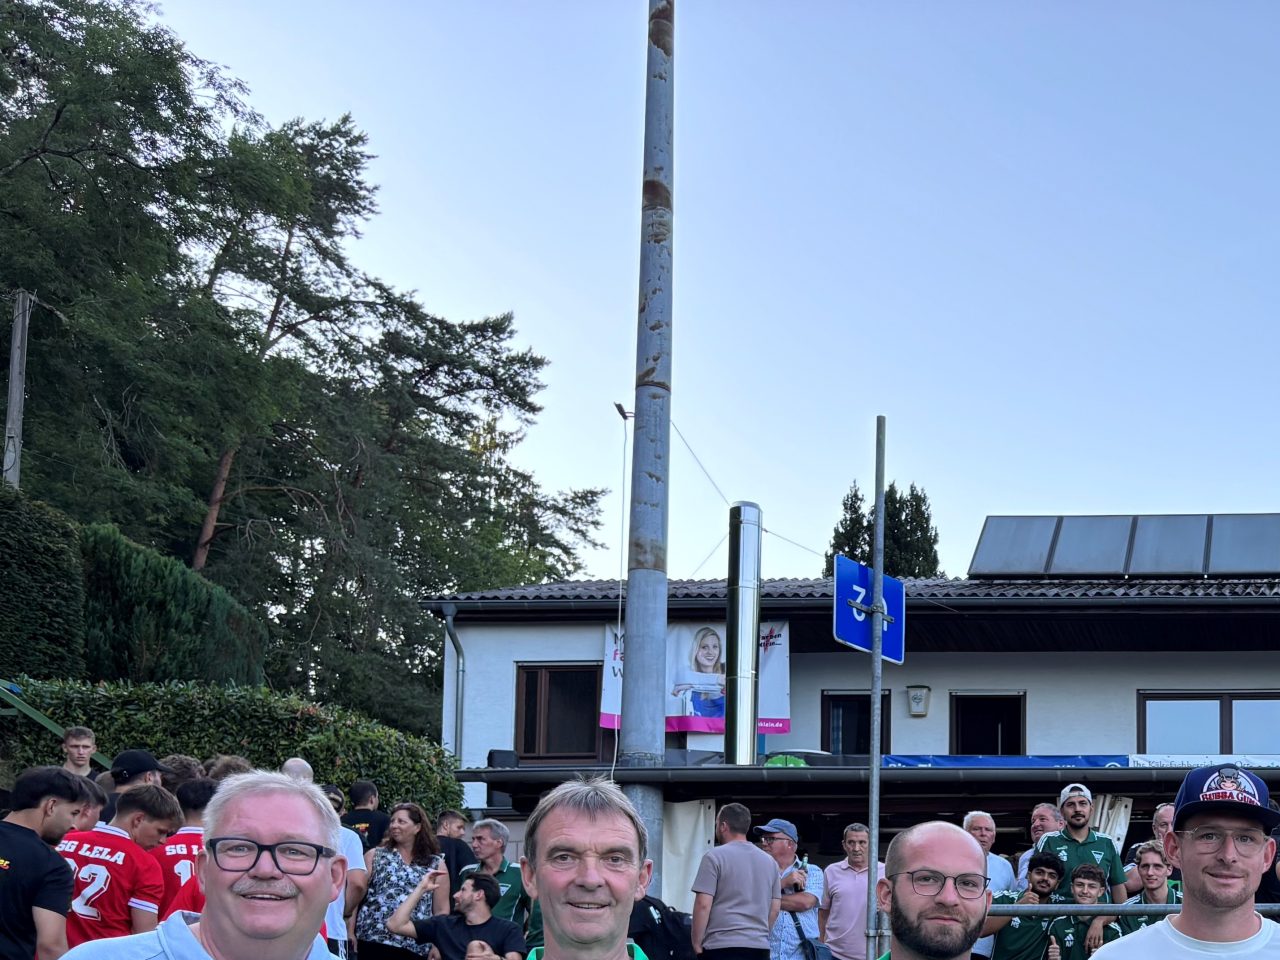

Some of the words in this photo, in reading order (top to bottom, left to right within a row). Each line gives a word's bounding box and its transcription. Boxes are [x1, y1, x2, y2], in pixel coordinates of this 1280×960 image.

[56, 839, 79, 853] SG
[78, 843, 126, 865] LELA
[165, 844, 187, 856] SG
